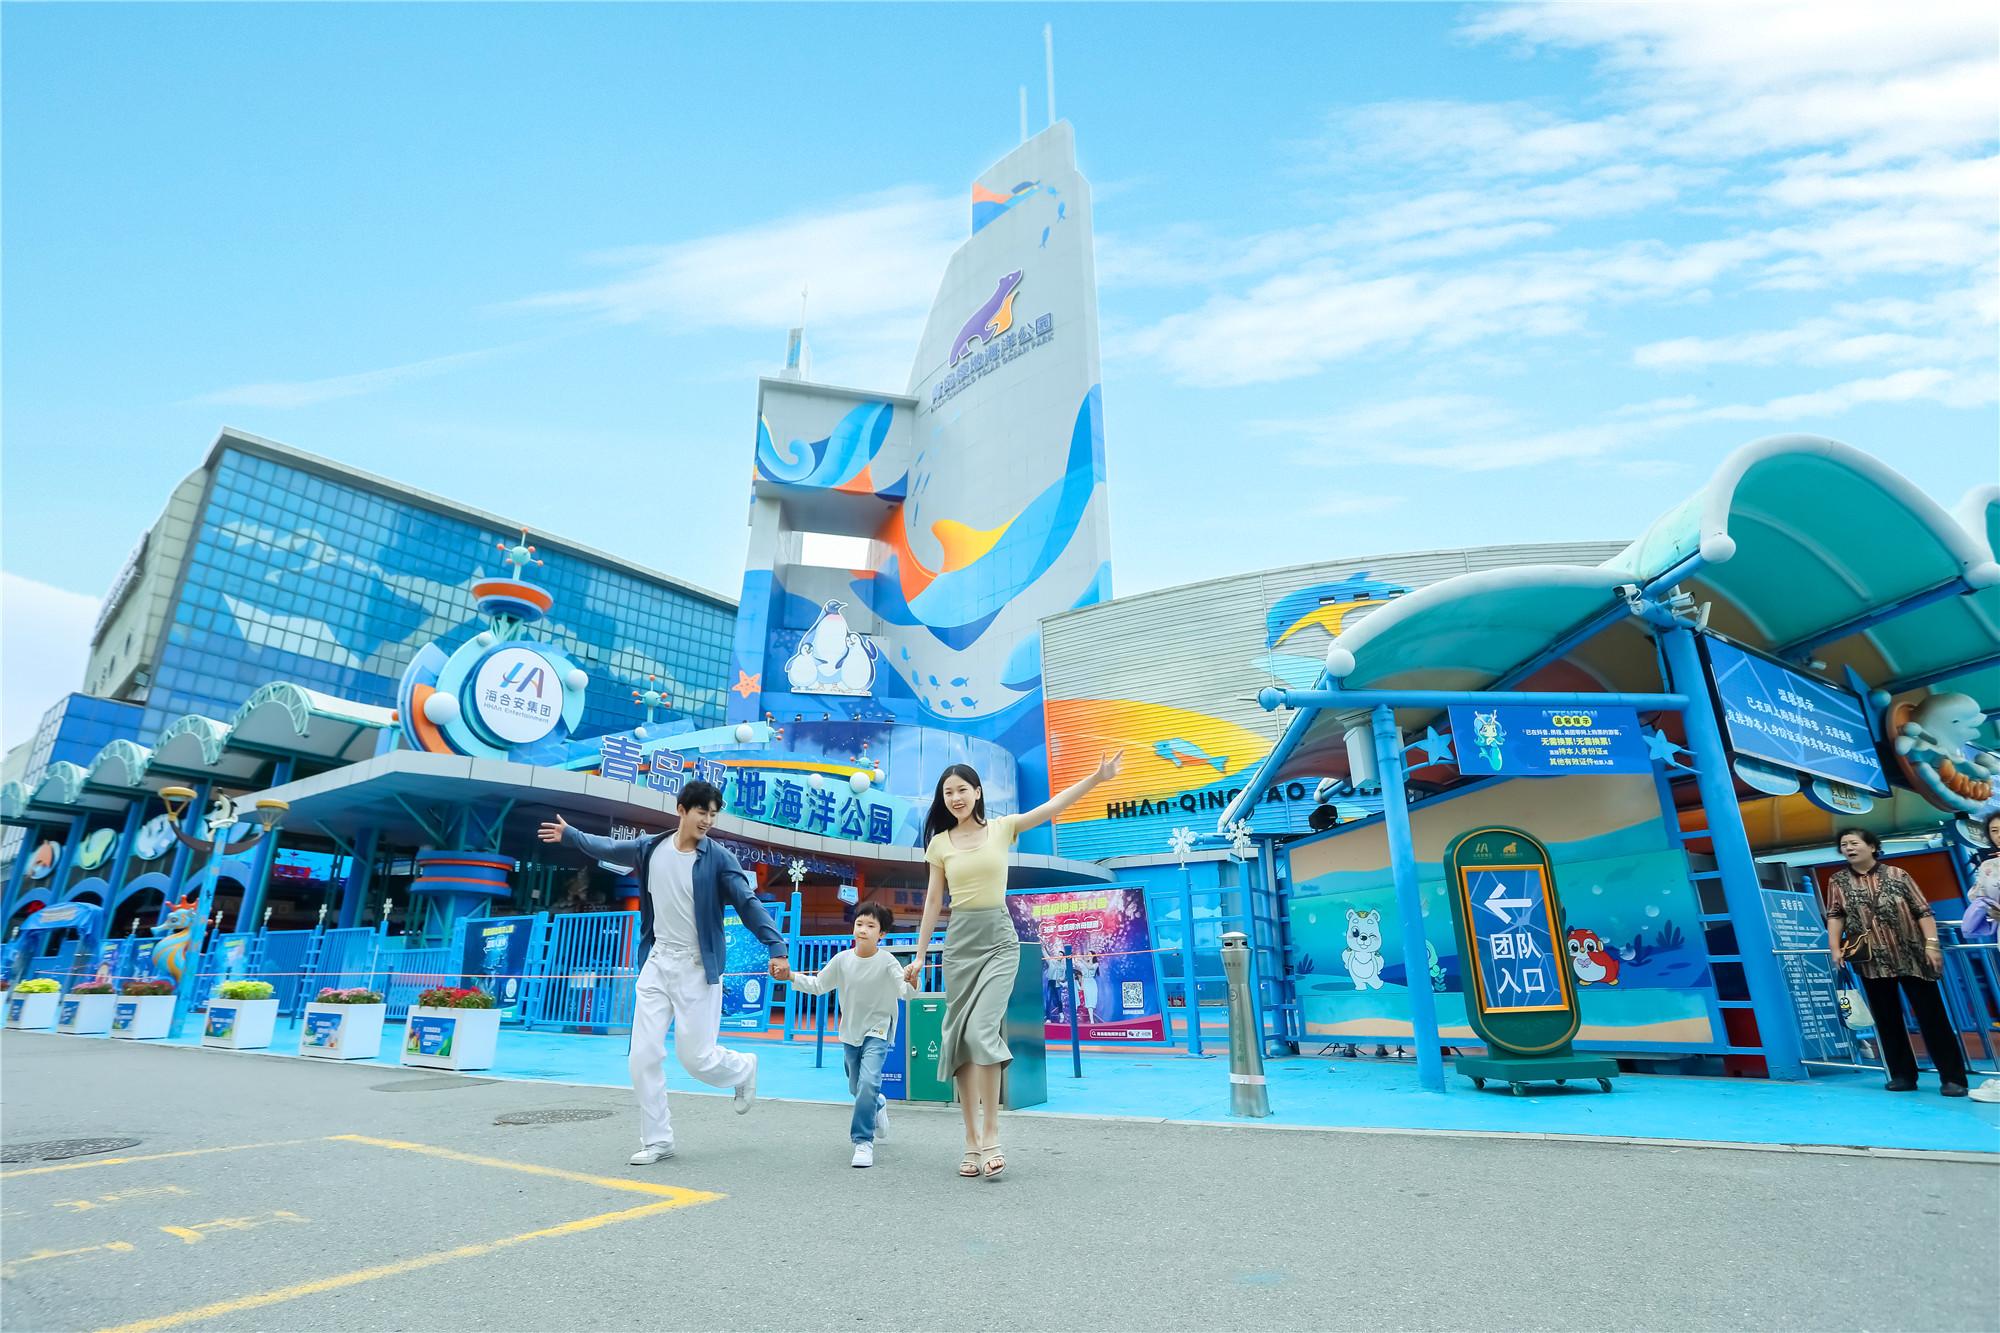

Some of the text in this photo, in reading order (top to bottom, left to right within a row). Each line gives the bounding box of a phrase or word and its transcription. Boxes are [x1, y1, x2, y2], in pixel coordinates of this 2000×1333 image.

[485, 688, 551, 717] 海合安集团
[601, 735, 893, 845] 青岛极地海洋公园
[1490, 933, 1542, 960] 团队
[1497, 968, 1546, 994] 入口
